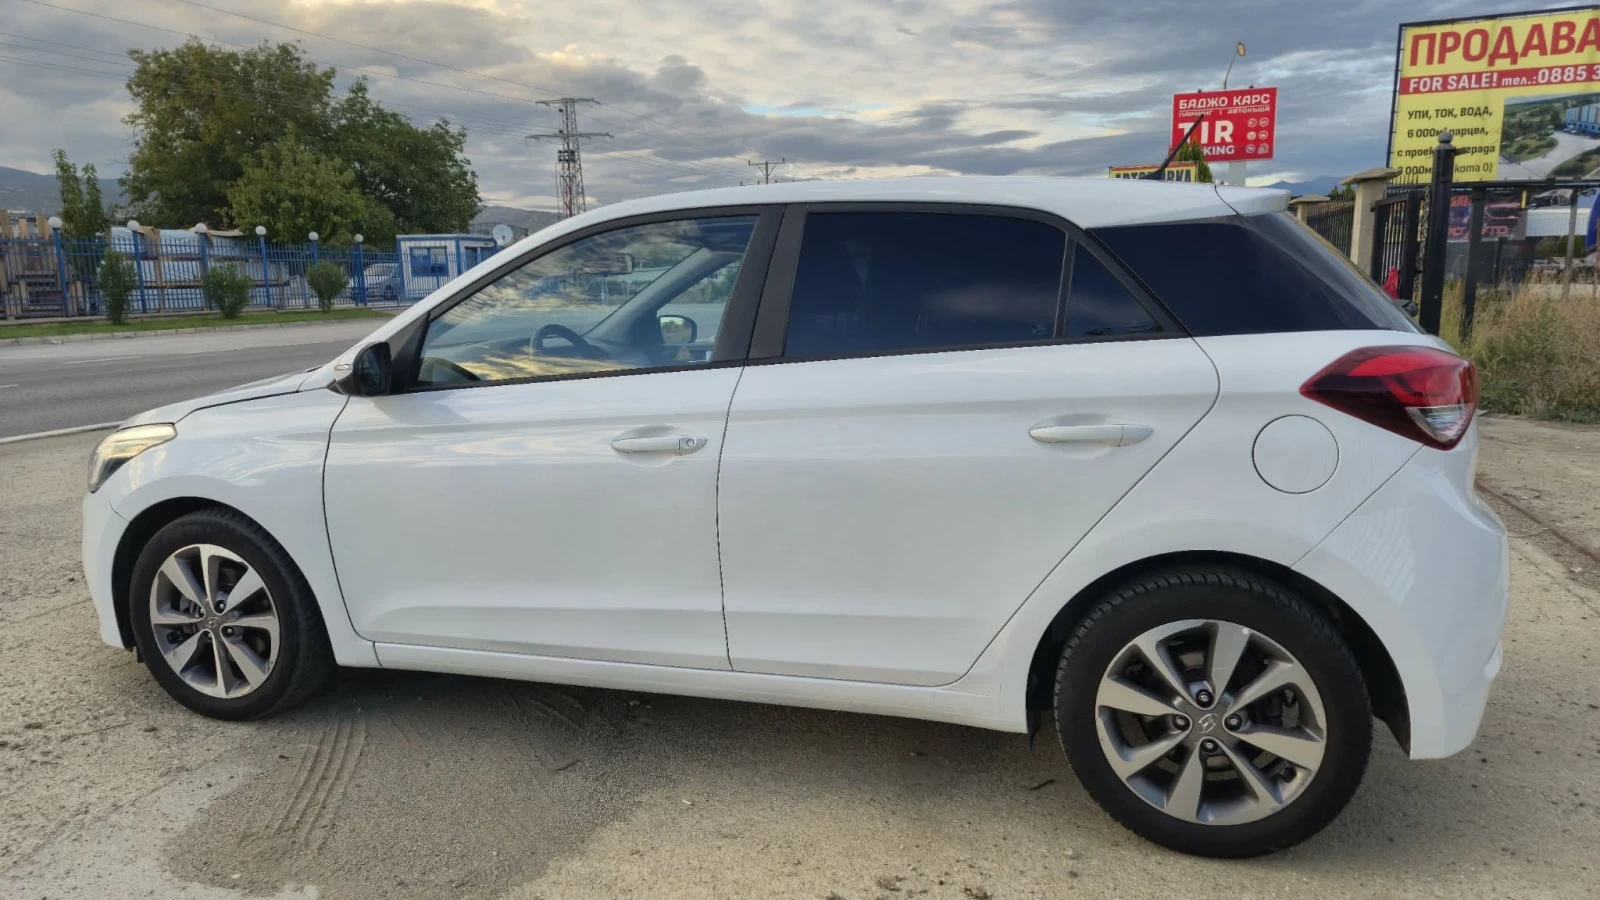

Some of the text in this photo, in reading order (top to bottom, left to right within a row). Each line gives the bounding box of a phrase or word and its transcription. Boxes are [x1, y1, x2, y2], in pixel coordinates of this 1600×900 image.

[1408, 77, 1442, 93] FOR
[1447, 72, 1498, 90] SALE!
[1179, 94, 1270, 109] БАДЖО КАРС
[1408, 106, 1493, 120] УПИ, ТОК, ВОДА,
[1178, 120, 1234, 145] TIR
[1407, 129, 1413, 138] 6
